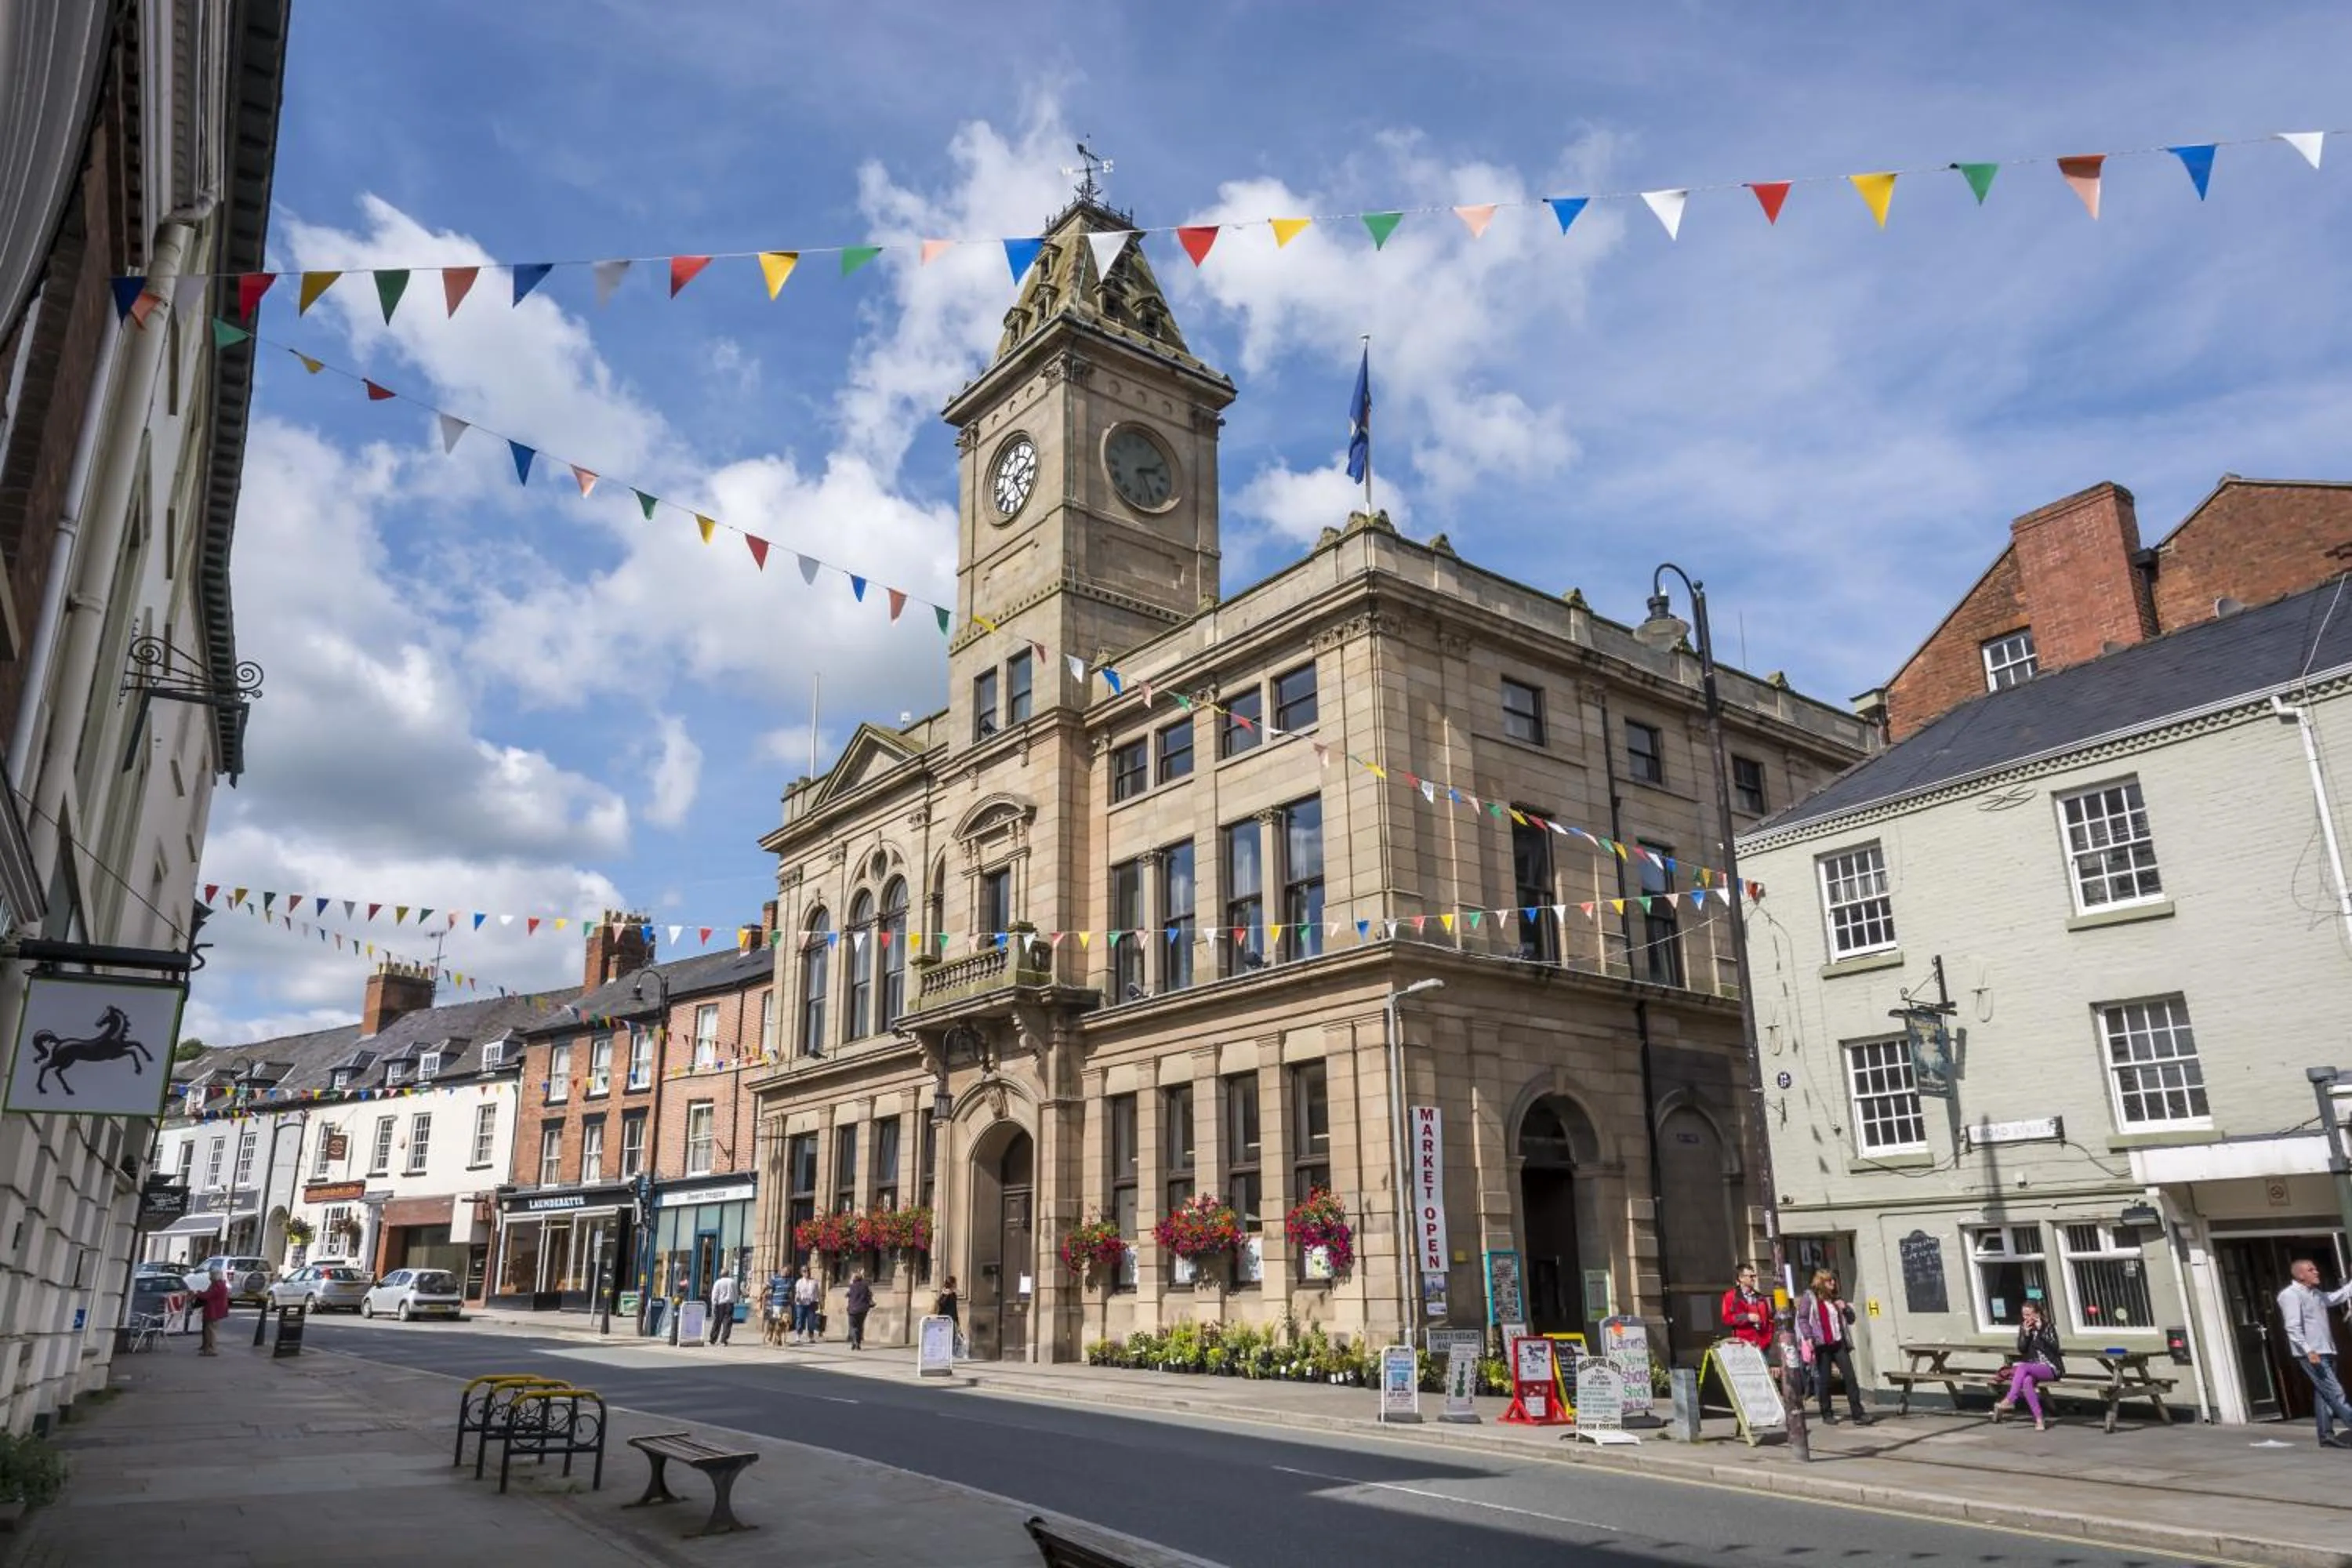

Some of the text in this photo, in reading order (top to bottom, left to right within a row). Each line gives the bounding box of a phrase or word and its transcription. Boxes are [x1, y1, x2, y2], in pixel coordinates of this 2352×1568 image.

[1419, 1108, 1434, 1199] MARKET
[1425, 1207, 1440, 1269] OPEN
[1868, 1301, 1879, 1316] H
